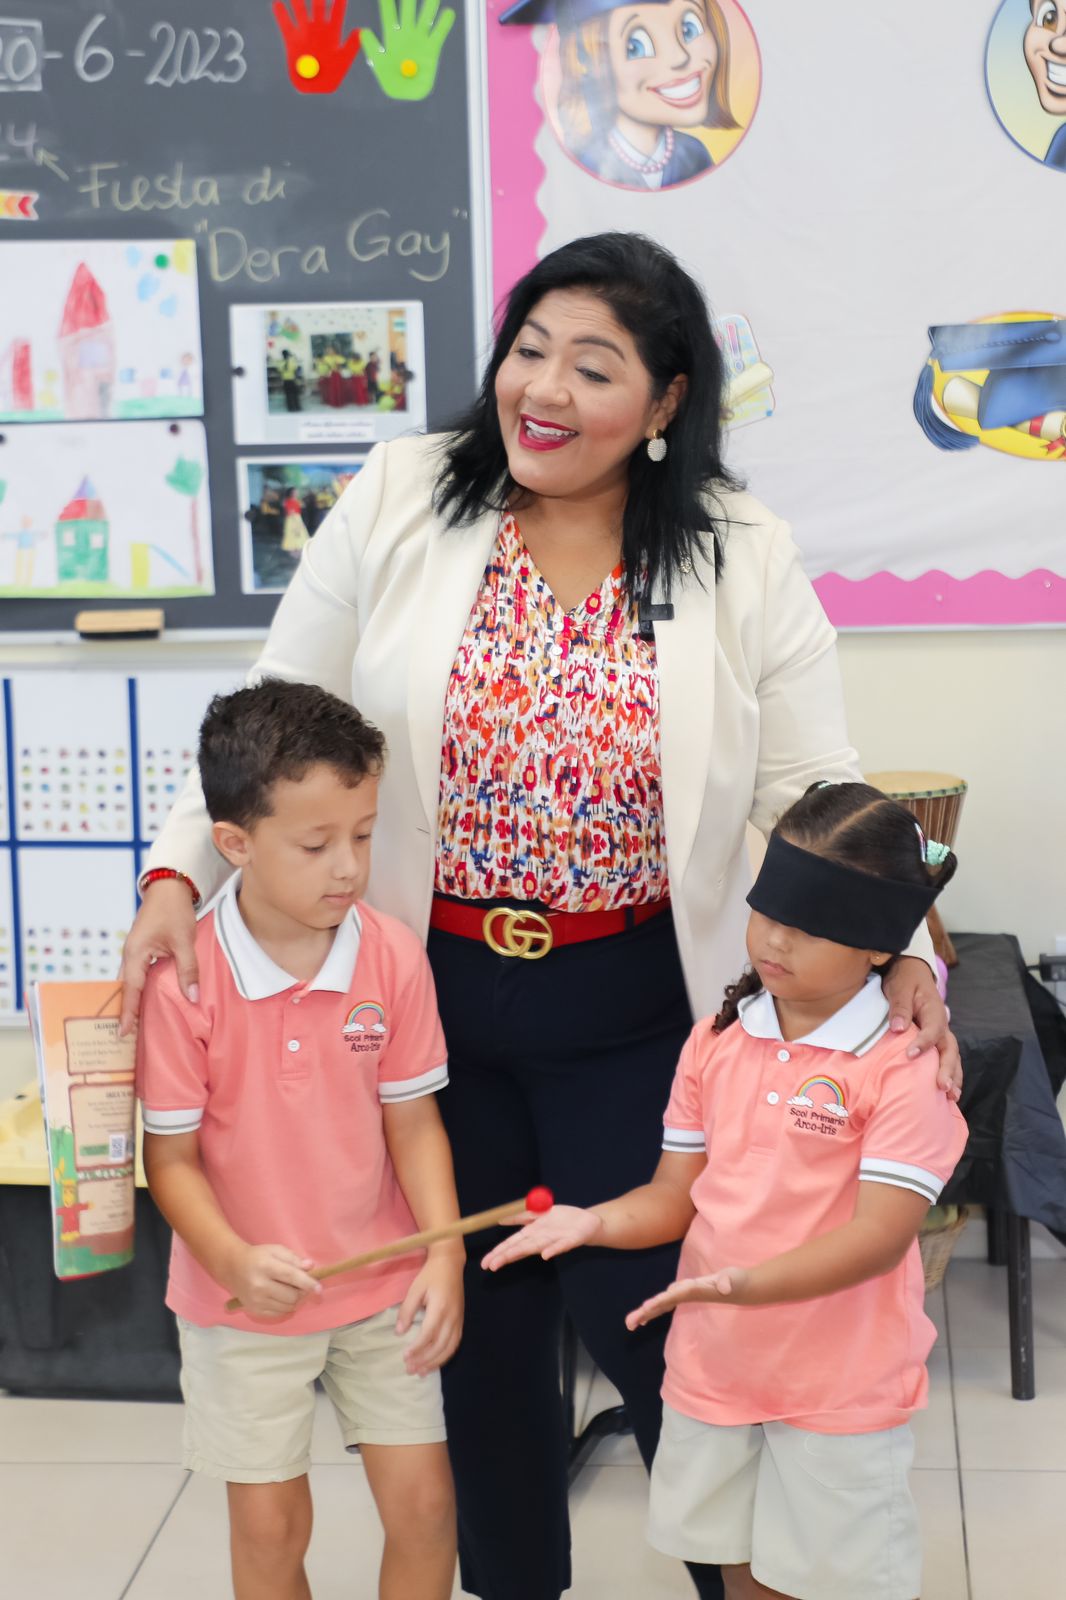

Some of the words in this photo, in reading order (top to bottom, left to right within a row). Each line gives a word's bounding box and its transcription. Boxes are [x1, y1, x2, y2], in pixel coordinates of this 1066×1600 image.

[0, 14, 247, 87] 0-6-2023
[0, 122, 39, 163] 4
[242, 161, 292, 205] di
[789, 1107, 808, 1118] Scol
[810, 1111, 845, 1127] Primario
[794, 1117, 838, 1136] Arco-Iris
